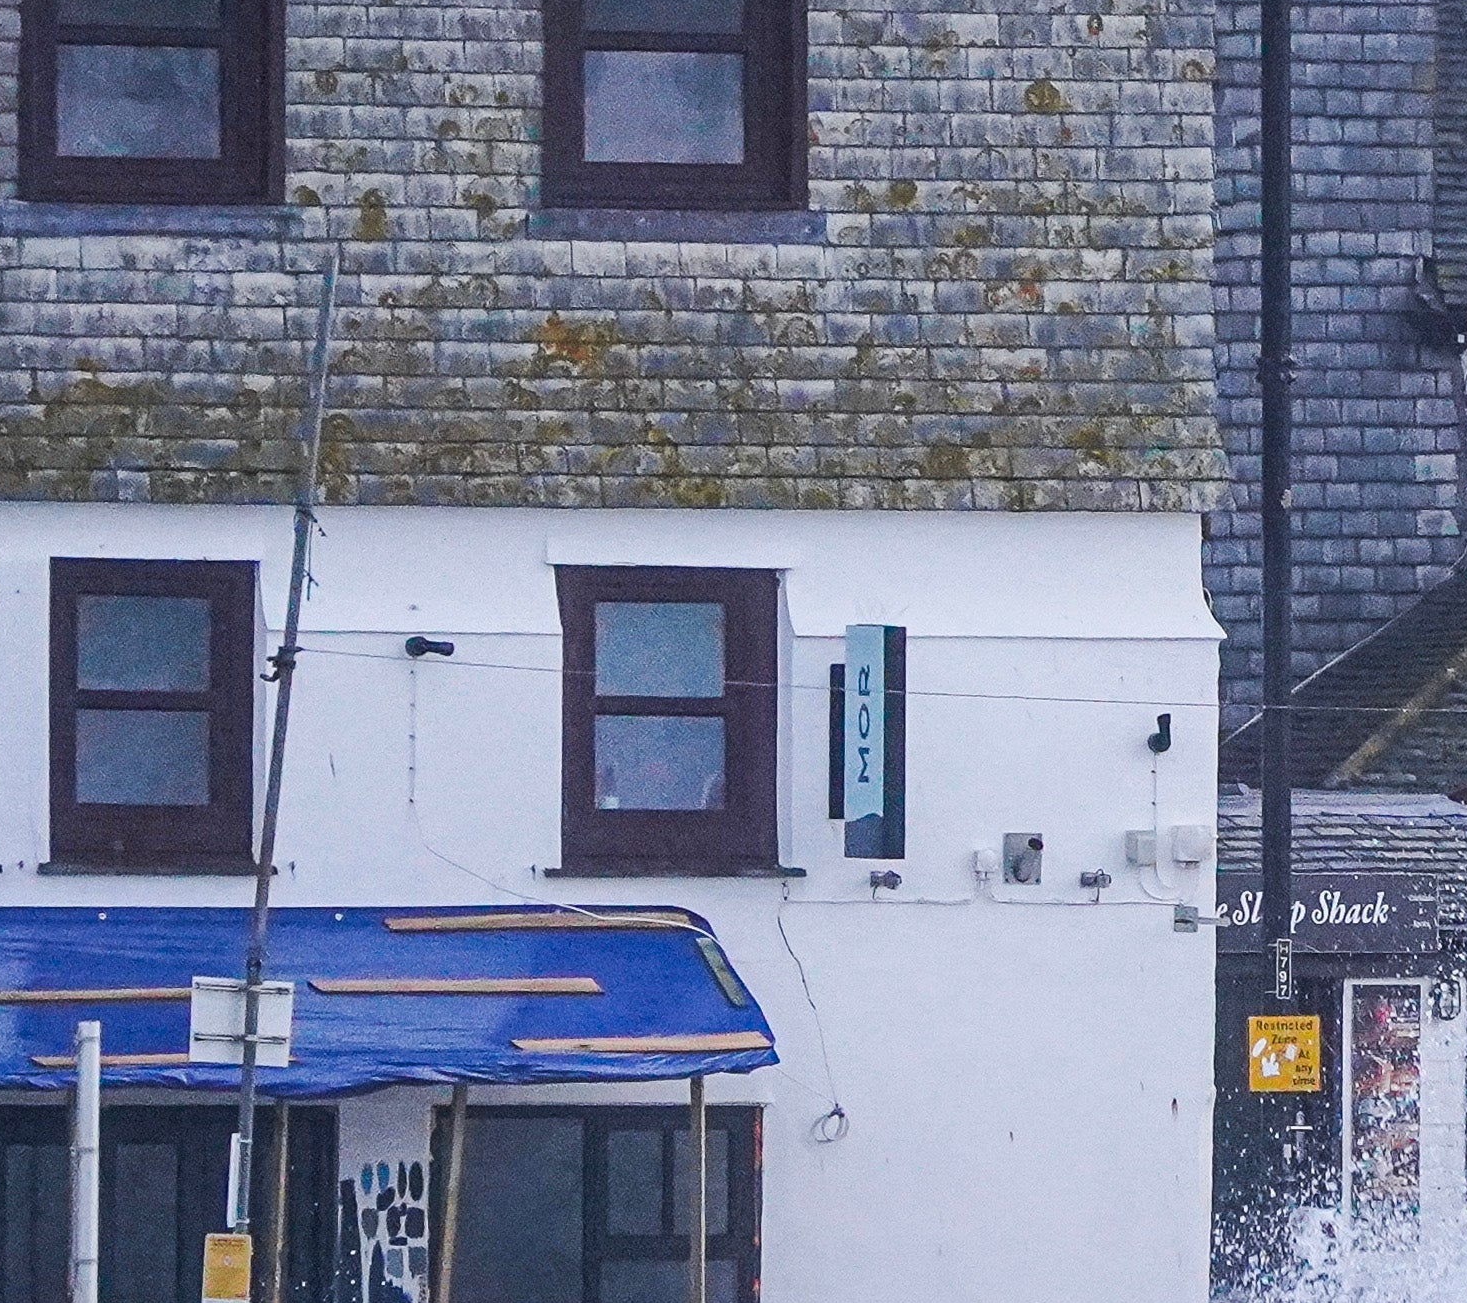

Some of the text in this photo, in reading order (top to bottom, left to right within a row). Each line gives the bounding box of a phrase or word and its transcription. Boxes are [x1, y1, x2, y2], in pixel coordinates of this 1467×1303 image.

[857, 663, 871, 784] MOR
[1232, 889, 1390, 934] Slp Shack
[1255, 1019, 1314, 1031] Restricted
[1271, 1033, 1298, 1045] Zone
[1298, 1048, 1311, 1060] At
